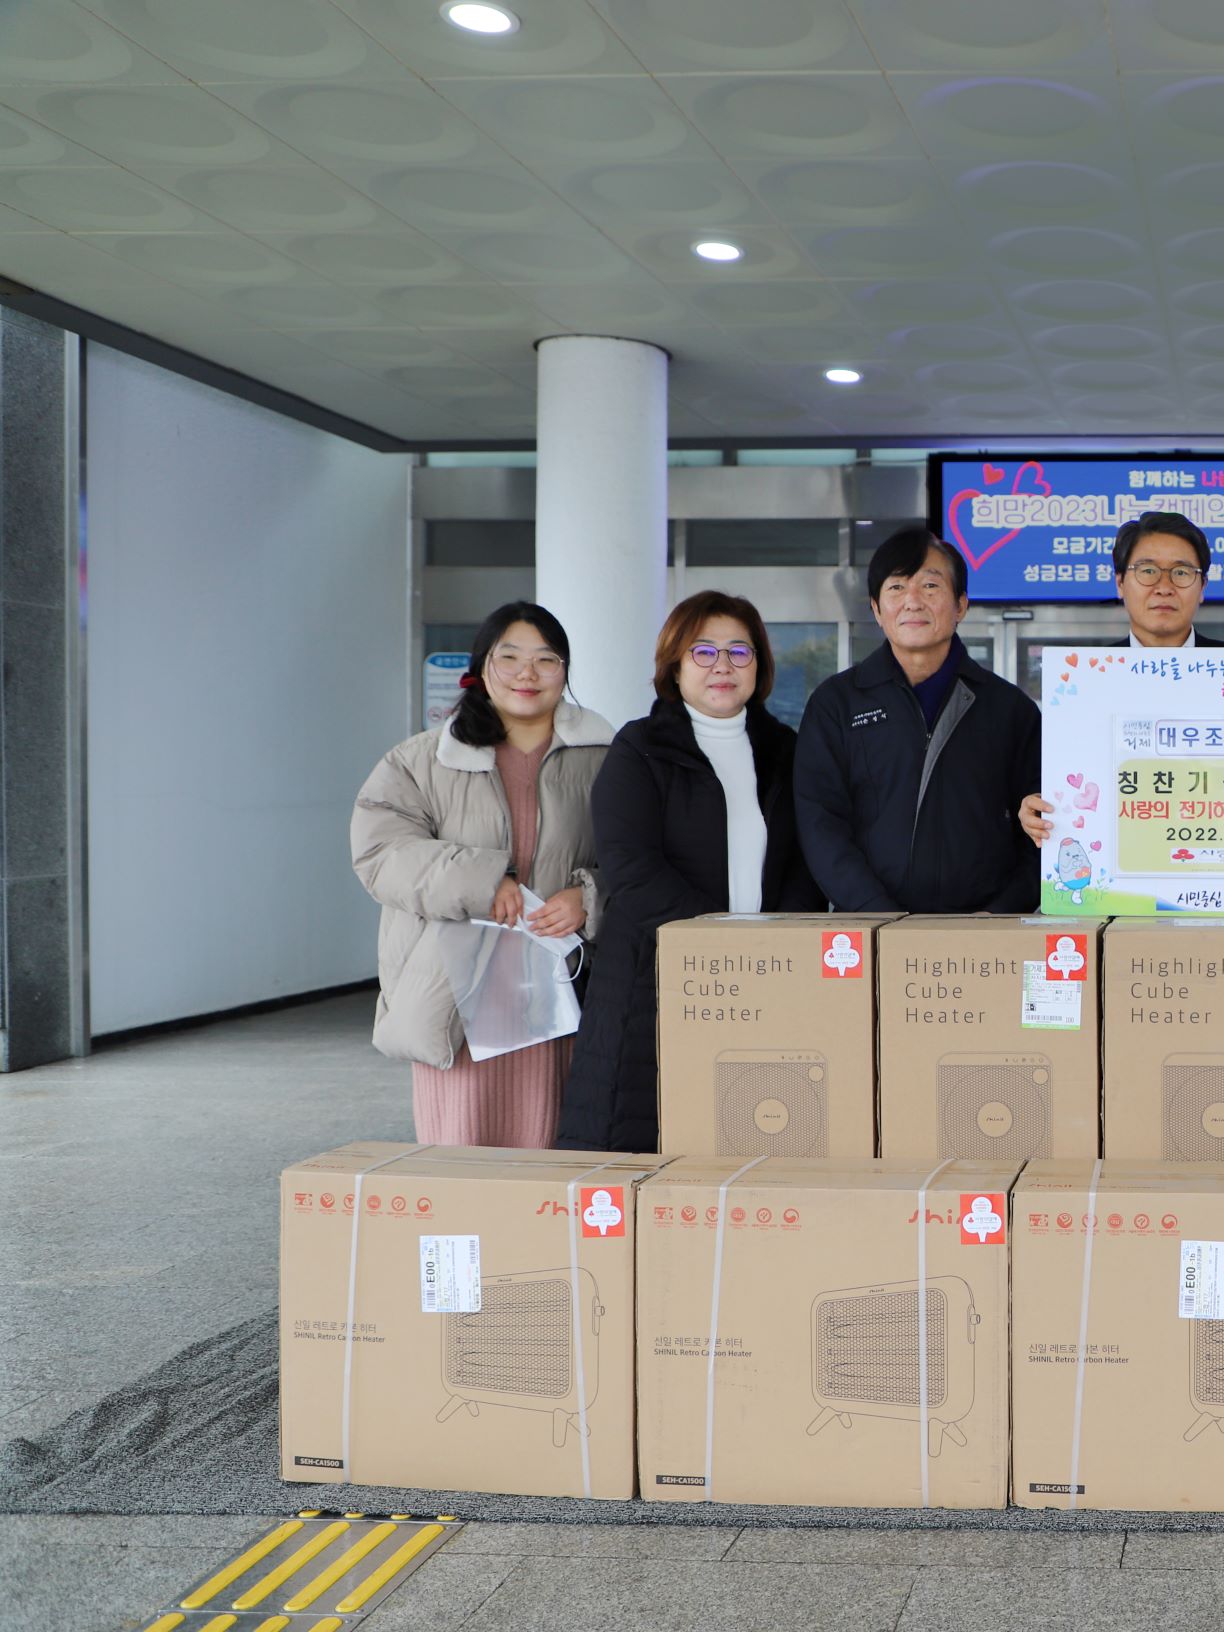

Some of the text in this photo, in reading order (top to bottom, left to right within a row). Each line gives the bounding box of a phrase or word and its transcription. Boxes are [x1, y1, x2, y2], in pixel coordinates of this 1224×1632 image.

[1128, 470, 1196, 488] 함께하는
[1024, 563, 1090, 582] 성금모금
[1095, 563, 1115, 581] 창
[1131, 657, 1182, 681] 사랑을
[1118, 800, 1170, 820] 사랑의
[1165, 827, 1224, 841] 2022.
[1176, 890, 1222, 908] 시민중심
[682, 955, 794, 975] Highlight
[905, 957, 1017, 977] Highlight
[683, 980, 741, 997] Cube
[905, 982, 963, 999] Cube
[1130, 982, 1189, 999] Cube
[683, 1005, 763, 1022] Heater
[905, 1007, 986, 1024] Heater
[1131, 1007, 1212, 1024] Heater
[294, 1319, 310, 1331] 신일
[313, 1320, 338, 1331] 레트로
[294, 1331, 385, 1343] SHINIL Retro Caon Heater
[654, 1336, 672, 1347] 신일
[674, 1336, 701, 1347] 레트로
[725, 1337, 743, 1348] 히터
[654, 1348, 678, 1356] SHINIL
[680, 1348, 700, 1356] Retro
[728, 1350, 752, 1358] Heater
[1029, 1344, 1047, 1354] 신일
[1049, 1344, 1077, 1354] 레트로
[1102, 1344, 1120, 1355] 히터
[1028, 1355, 1053, 1363] SHINIL
[1105, 1356, 1129, 1364] Heater
[299, 1457, 340, 1467] SEH-CA1500
[662, 1476, 704, 1485] SEH-CA1500
